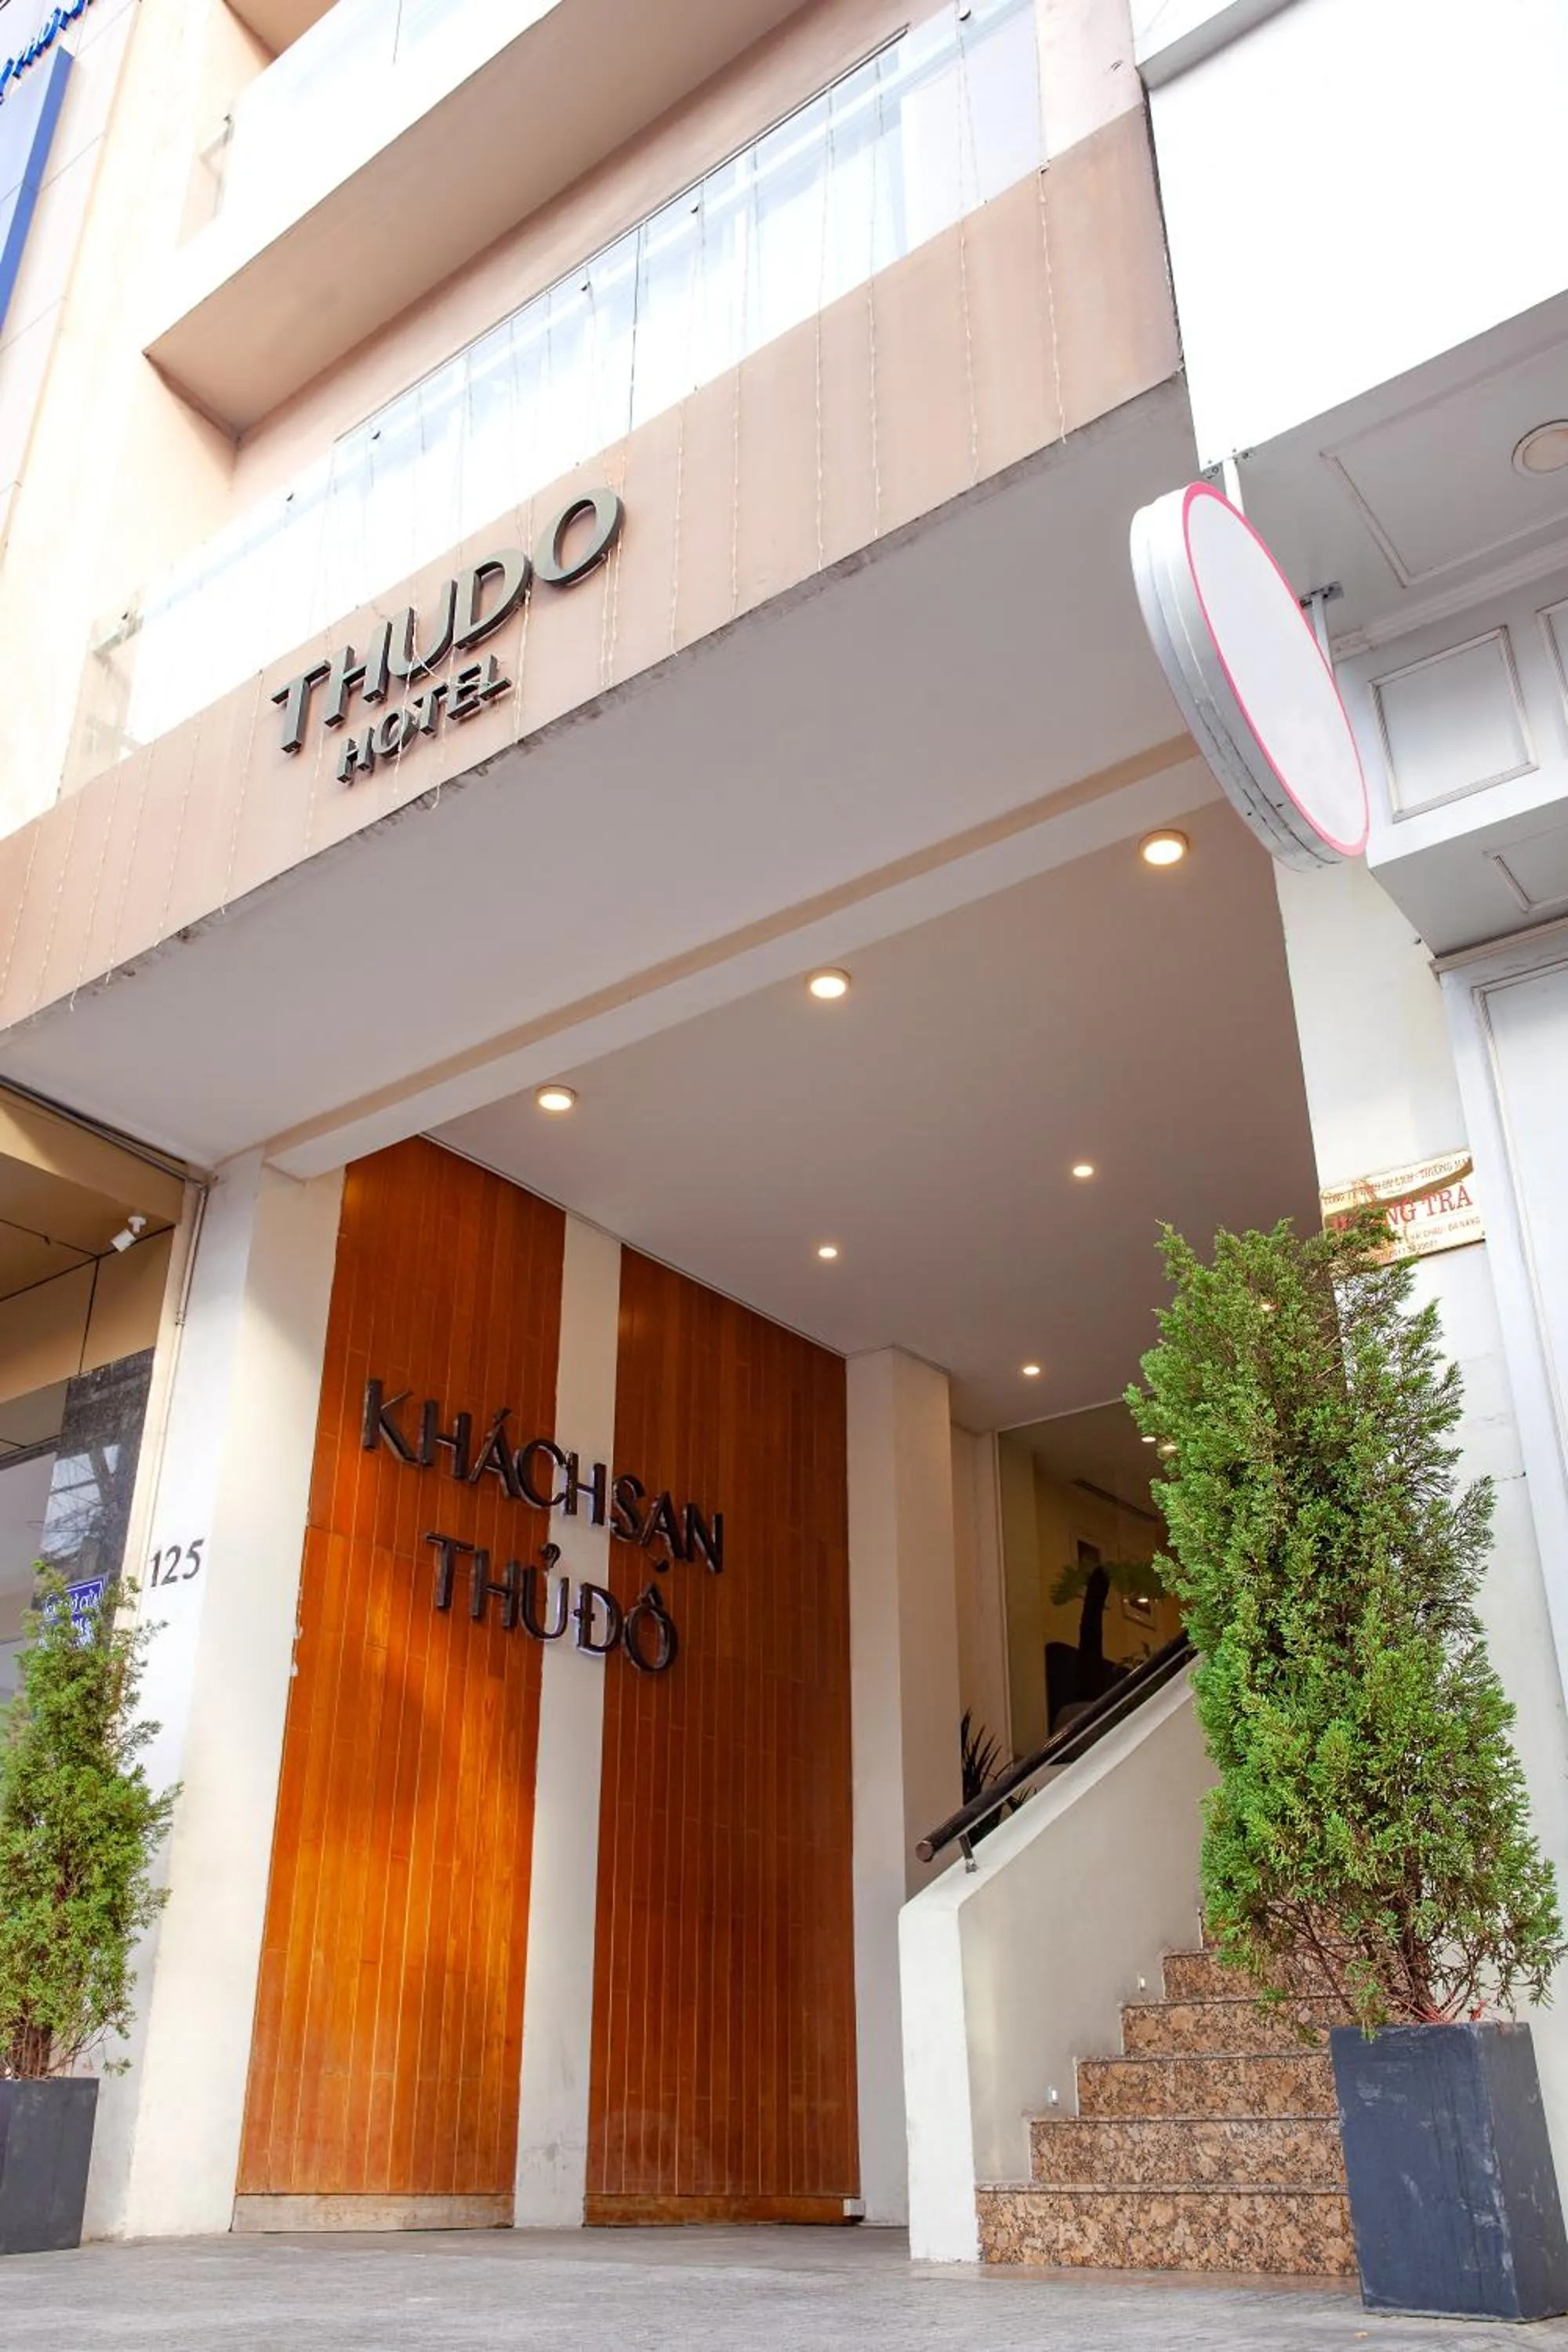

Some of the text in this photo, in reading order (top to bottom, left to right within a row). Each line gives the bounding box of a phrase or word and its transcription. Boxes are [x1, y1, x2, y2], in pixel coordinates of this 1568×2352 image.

[270, 487, 625, 753] THUDO
[336, 654, 512, 783] HOTEL
[150, 1537, 205, 1588] 125
